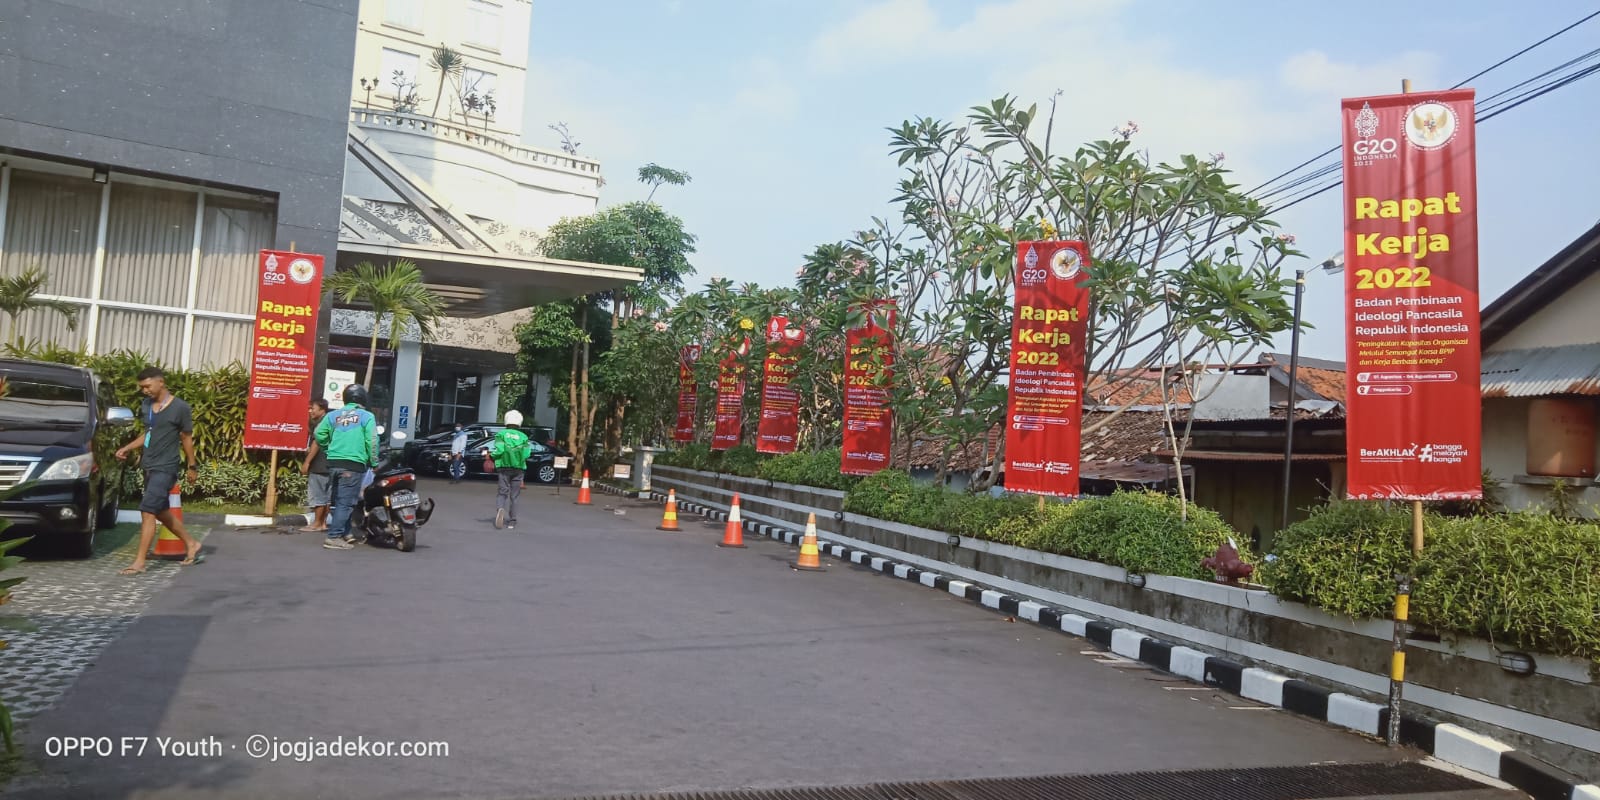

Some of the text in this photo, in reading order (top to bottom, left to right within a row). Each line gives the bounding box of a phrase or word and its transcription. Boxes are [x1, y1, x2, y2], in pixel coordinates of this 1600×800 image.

[1353, 138, 1397, 155] G20
[1355, 192, 1461, 222] Rapat
[1356, 227, 1449, 259] Kerja
[263, 272, 286, 281] G20
[1022, 269, 1047, 279] G20
[1355, 267, 1431, 289] 2022
[261, 300, 312, 317] Rapat
[1355, 296, 1462, 307] Badan Pembinaan
[1020, 305, 1079, 324] Rapat
[1355, 309, 1463, 322] Ideologi Pancasila
[259, 318, 305, 335] Kerja
[1355, 322, 1469, 336] Republik Indonesia
[257, 336, 295, 349] 2022
[1018, 328, 1070, 348] Kerja
[1017, 351, 1058, 365] 2022
[1360, 448, 1415, 457] BerAKHLAK
